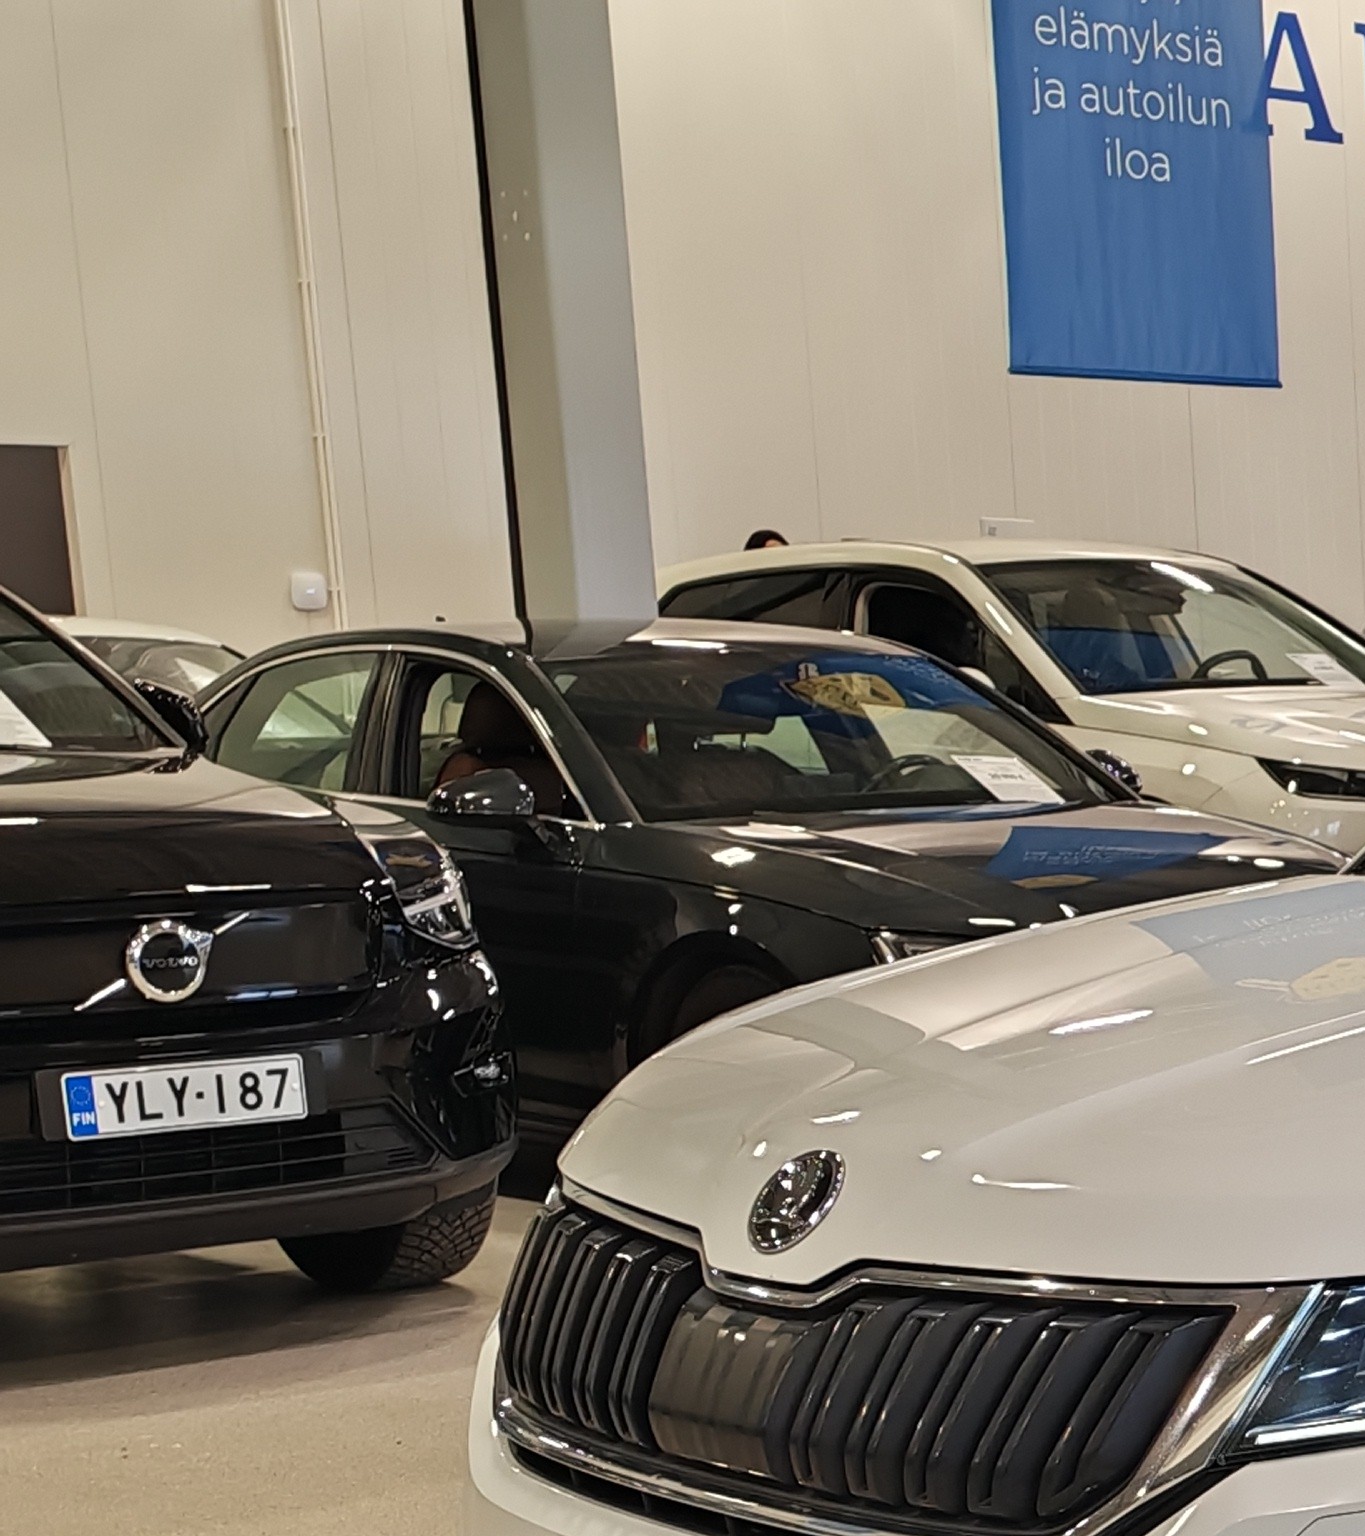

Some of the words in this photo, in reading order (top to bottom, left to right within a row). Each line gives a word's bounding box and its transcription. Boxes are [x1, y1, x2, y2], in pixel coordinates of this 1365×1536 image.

[1034, 5, 1223, 67] elämyksiä
[1032, 67, 1066, 115] ja
[1080, 79, 1231, 129] autoilun
[1105, 137, 1171, 182] iloa
[142, 955, 199, 969] VOLVO
[72, 1111, 96, 1128] FIN
[105, 1067, 290, 1125] YLY-187
